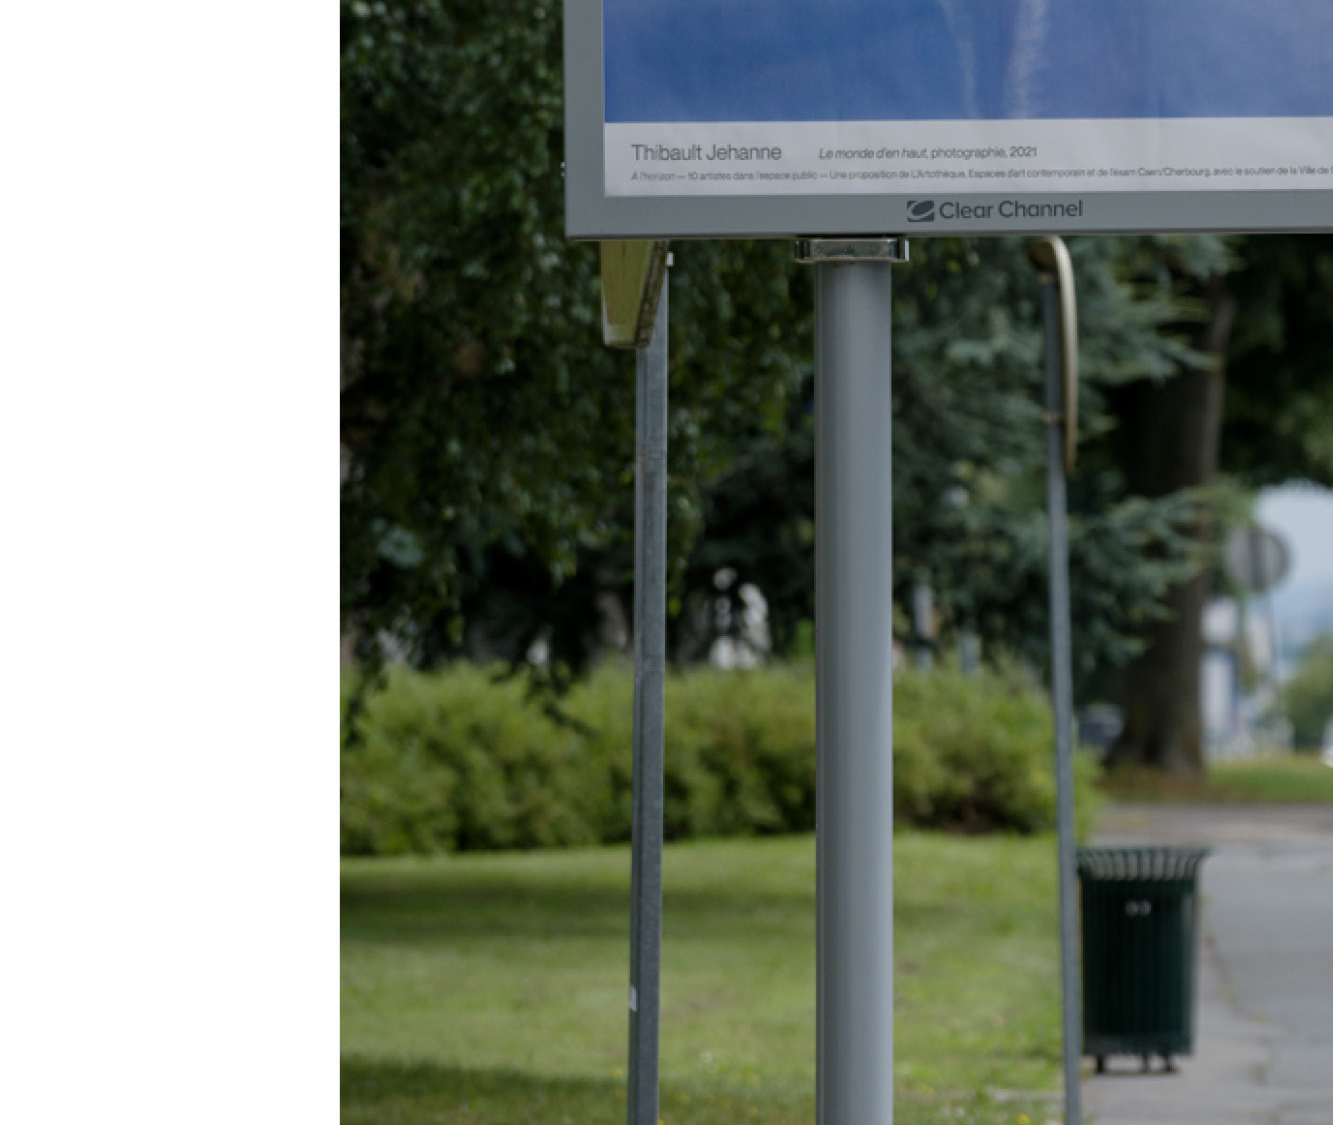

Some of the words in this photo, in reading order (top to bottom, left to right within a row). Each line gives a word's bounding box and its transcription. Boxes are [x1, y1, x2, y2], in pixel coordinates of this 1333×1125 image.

[631, 144, 702, 161] Thibault
[706, 144, 782, 161] Jehanne
[818, 148, 833, 159] Le
[835, 147, 875, 159] monde
[1008, 146, 1037, 157] 2021
[940, 200, 993, 219] Clear
[998, 198, 1083, 218] Channel
